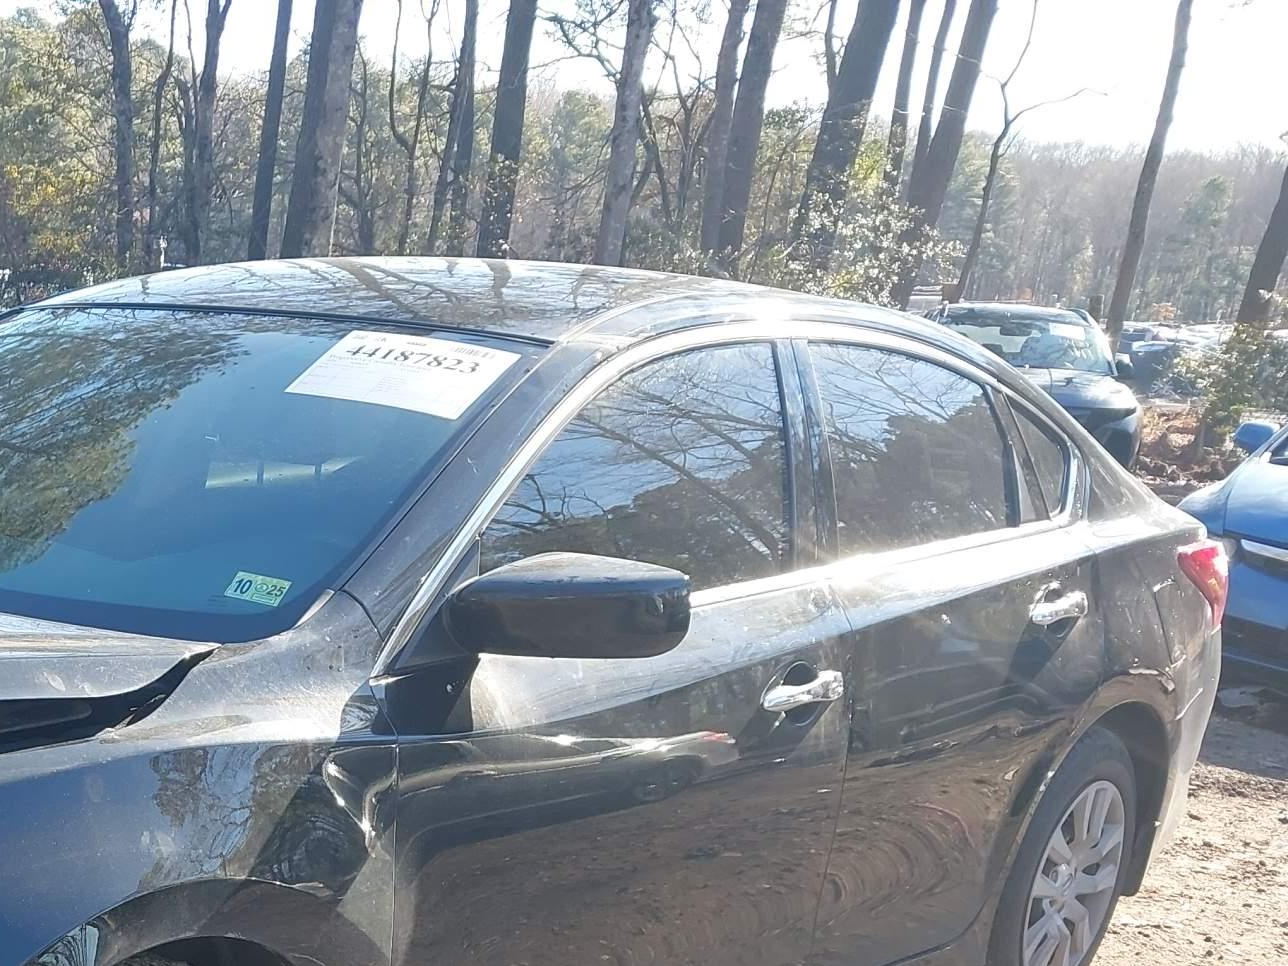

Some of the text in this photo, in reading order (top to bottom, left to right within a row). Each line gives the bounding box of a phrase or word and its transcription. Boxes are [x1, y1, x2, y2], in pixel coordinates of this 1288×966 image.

[346, 344, 480, 374] 44187823
[233, 578, 253, 595] 10
[265, 584, 286, 598] 25
